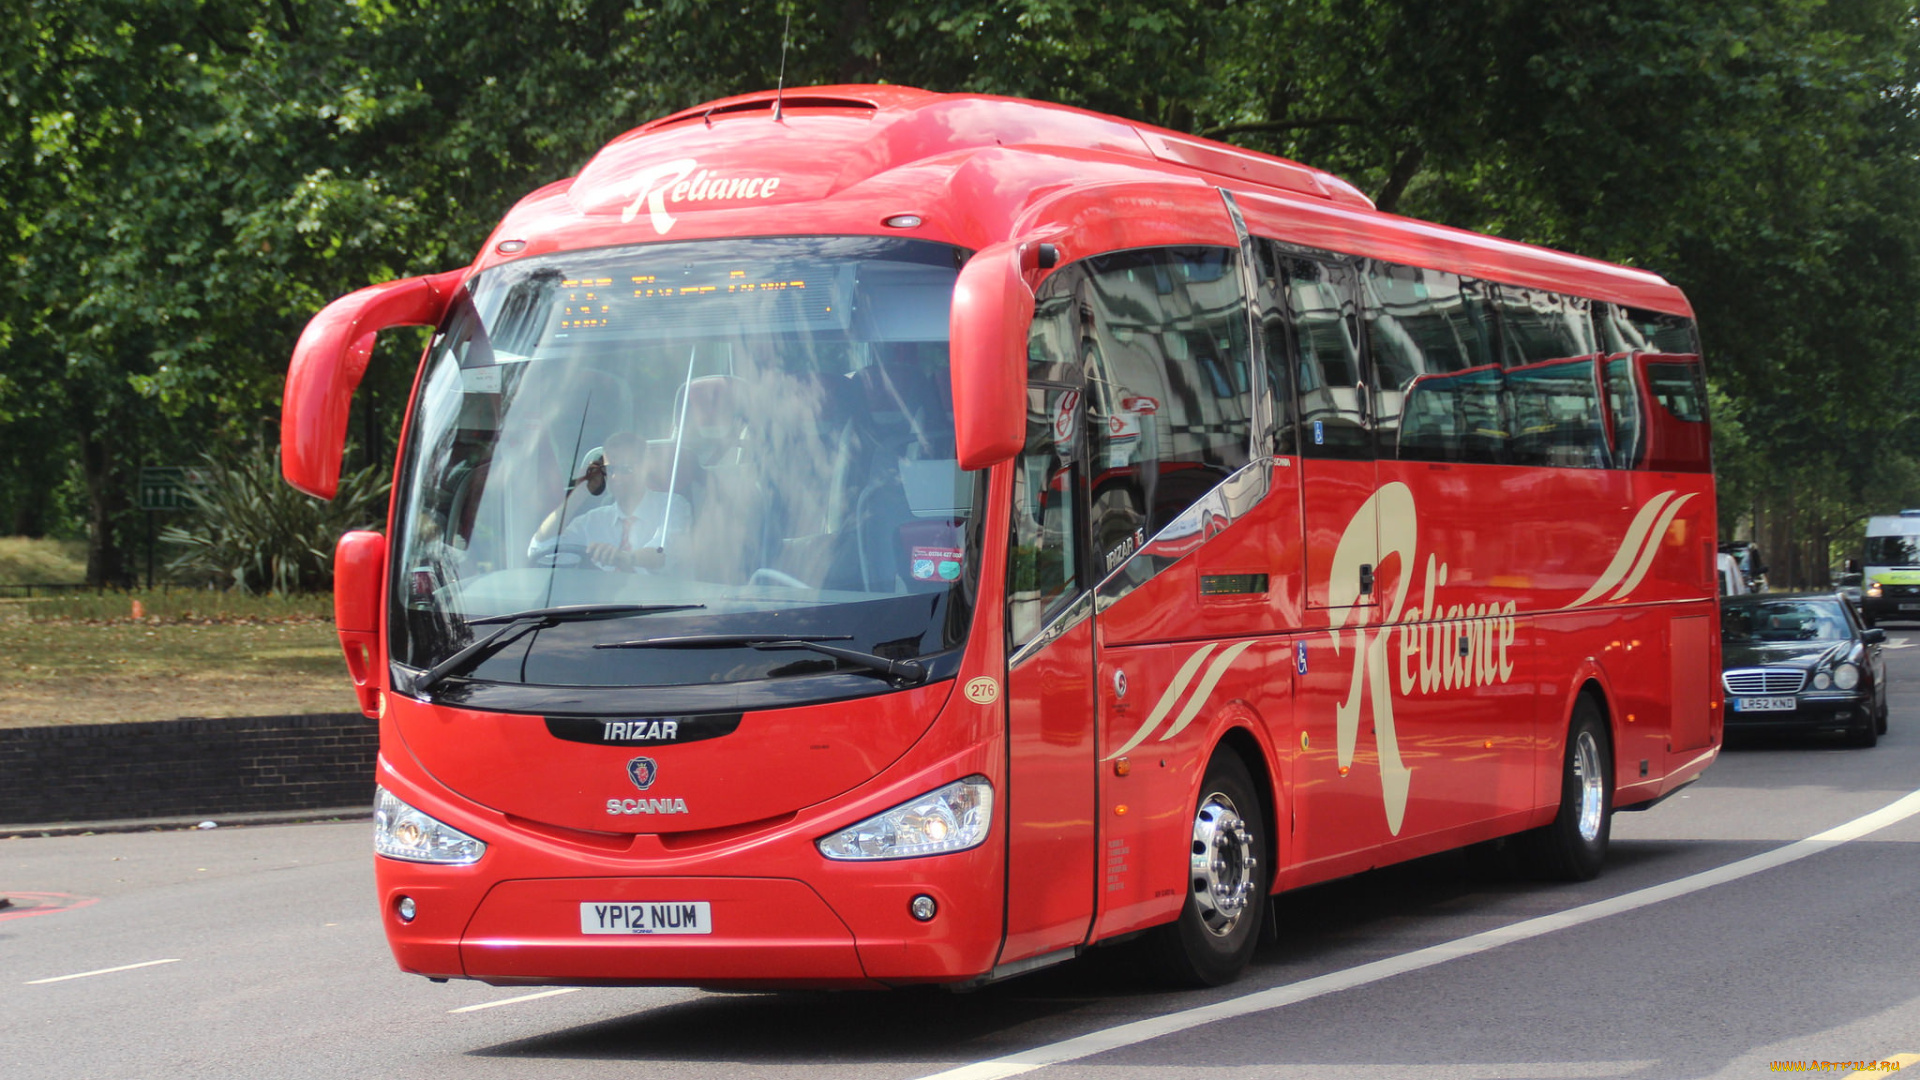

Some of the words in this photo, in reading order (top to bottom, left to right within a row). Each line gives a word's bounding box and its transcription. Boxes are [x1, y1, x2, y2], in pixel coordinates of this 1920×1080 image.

[620, 159, 781, 235] Reliance
[1105, 536, 1134, 573] IRIZAR
[1328, 481, 1517, 837] Reliance
[971, 683, 995, 697] 276
[1741, 699, 1770, 710] LR52
[603, 721, 679, 741] IRIZAR
[606, 798, 689, 815] SCANIA
[594, 905, 645, 929] YP12
[651, 904, 698, 929] NUM
